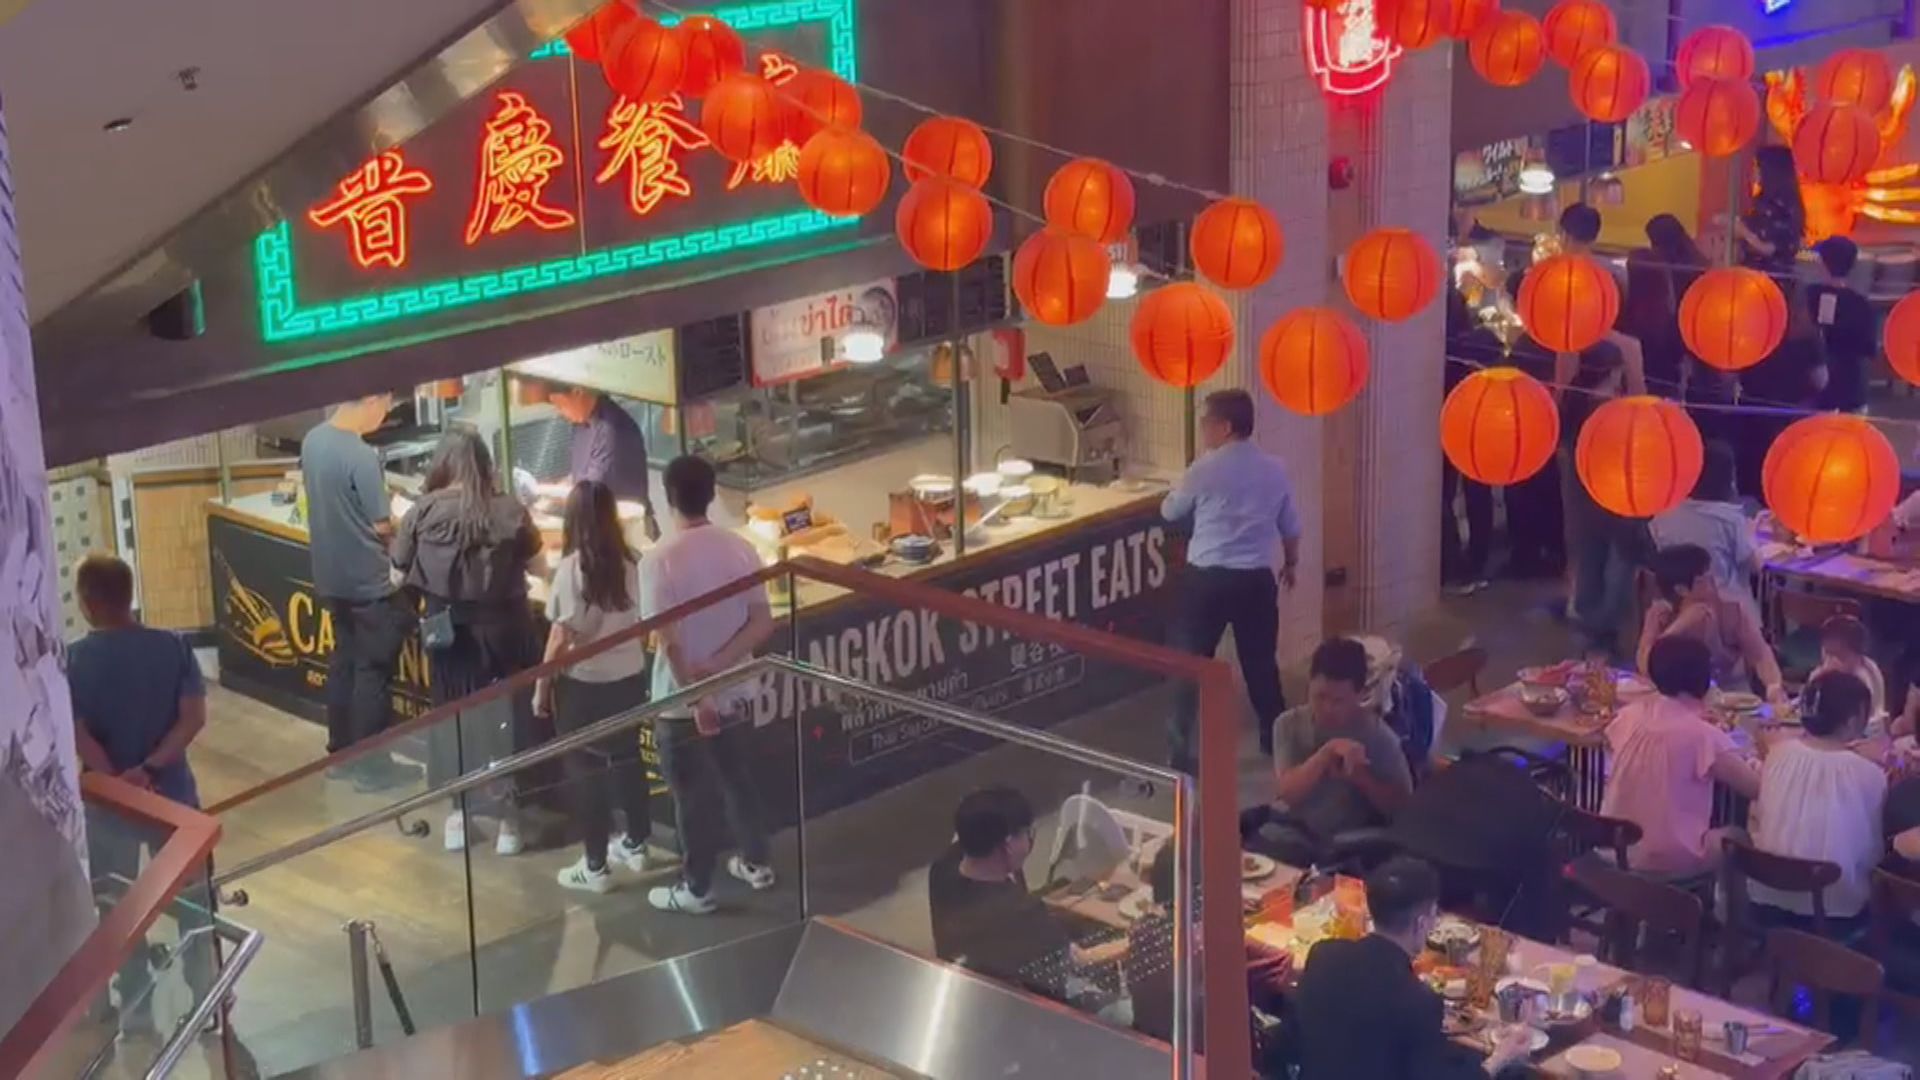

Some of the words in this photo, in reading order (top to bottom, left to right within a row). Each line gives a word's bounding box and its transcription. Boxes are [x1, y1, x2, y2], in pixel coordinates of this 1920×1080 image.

[752, 606, 945, 729] BANGKOK
[958, 552, 1080, 654] STREET
[1090, 525, 1167, 610] EATS
